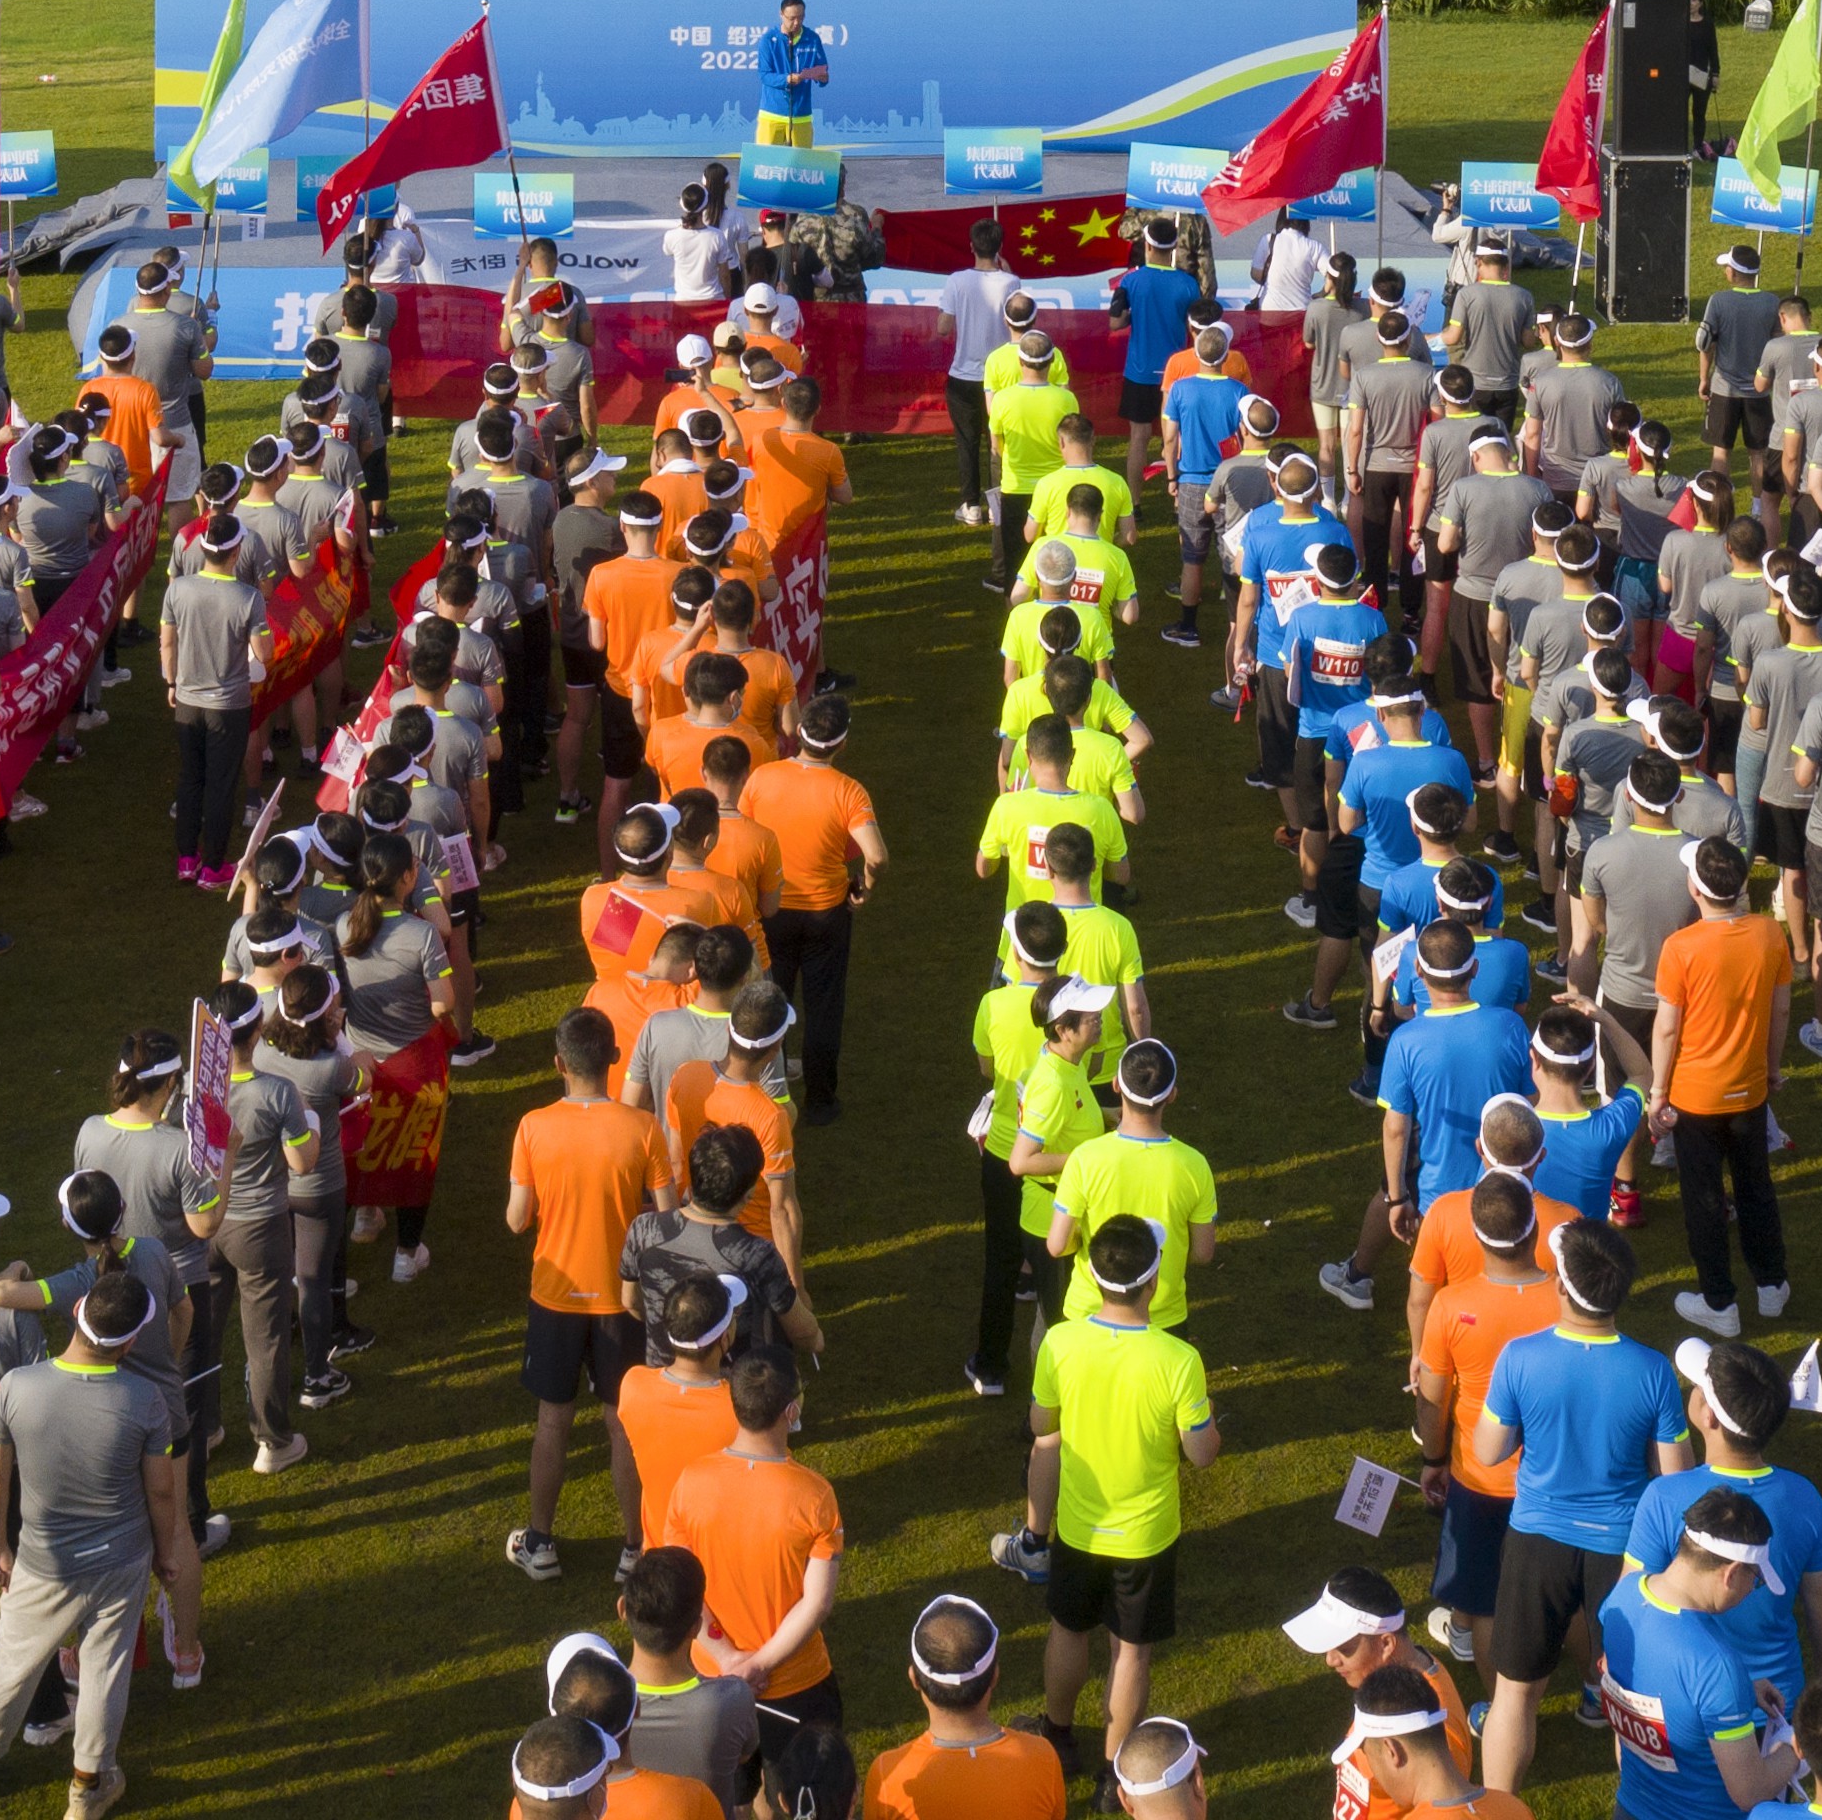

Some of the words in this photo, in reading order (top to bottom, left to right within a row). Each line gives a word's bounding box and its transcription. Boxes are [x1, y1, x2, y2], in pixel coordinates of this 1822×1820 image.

[669, 26, 712, 46] 中国
[966, 146, 1025, 162] 集团高管
[752, 164, 827, 186] 嘉宾代表队
[973, 163, 1018, 180] 代表队
[1150, 161, 1208, 181] 技术精英
[1155, 179, 1200, 197] 代表队
[1489, 196, 1533, 214] 代表队
[1318, 655, 1360, 675] W110
[1606, 1698, 1660, 1753] W108
